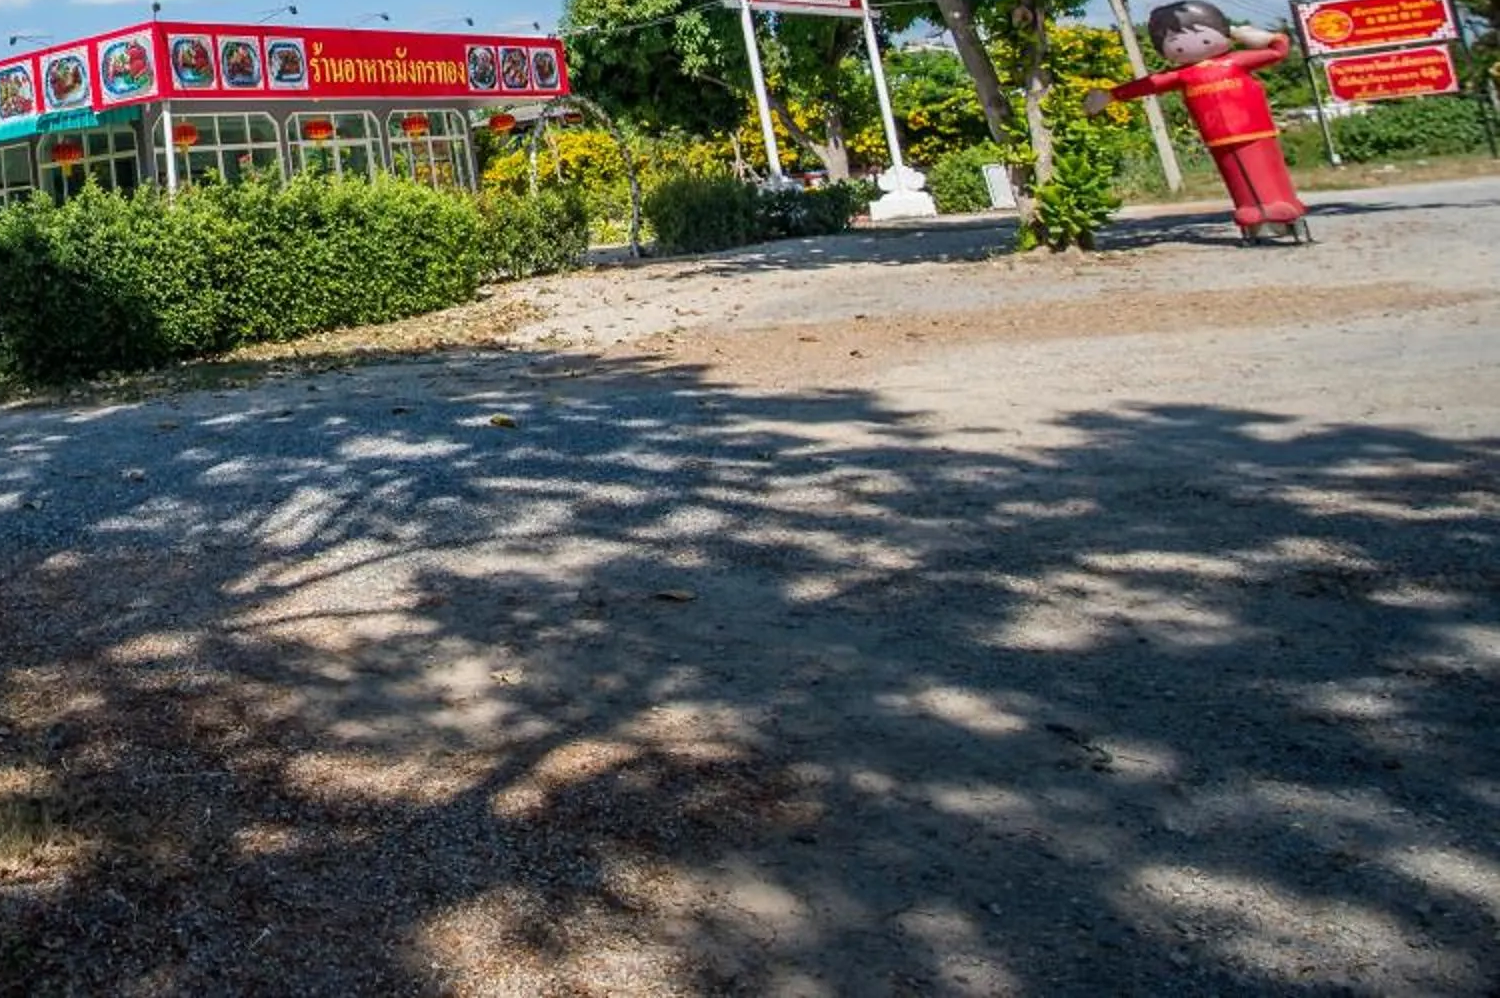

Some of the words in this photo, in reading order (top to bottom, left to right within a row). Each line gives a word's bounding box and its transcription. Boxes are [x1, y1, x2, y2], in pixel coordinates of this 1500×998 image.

[309, 41, 467, 85] ร้านอาหารมังกรทอง
